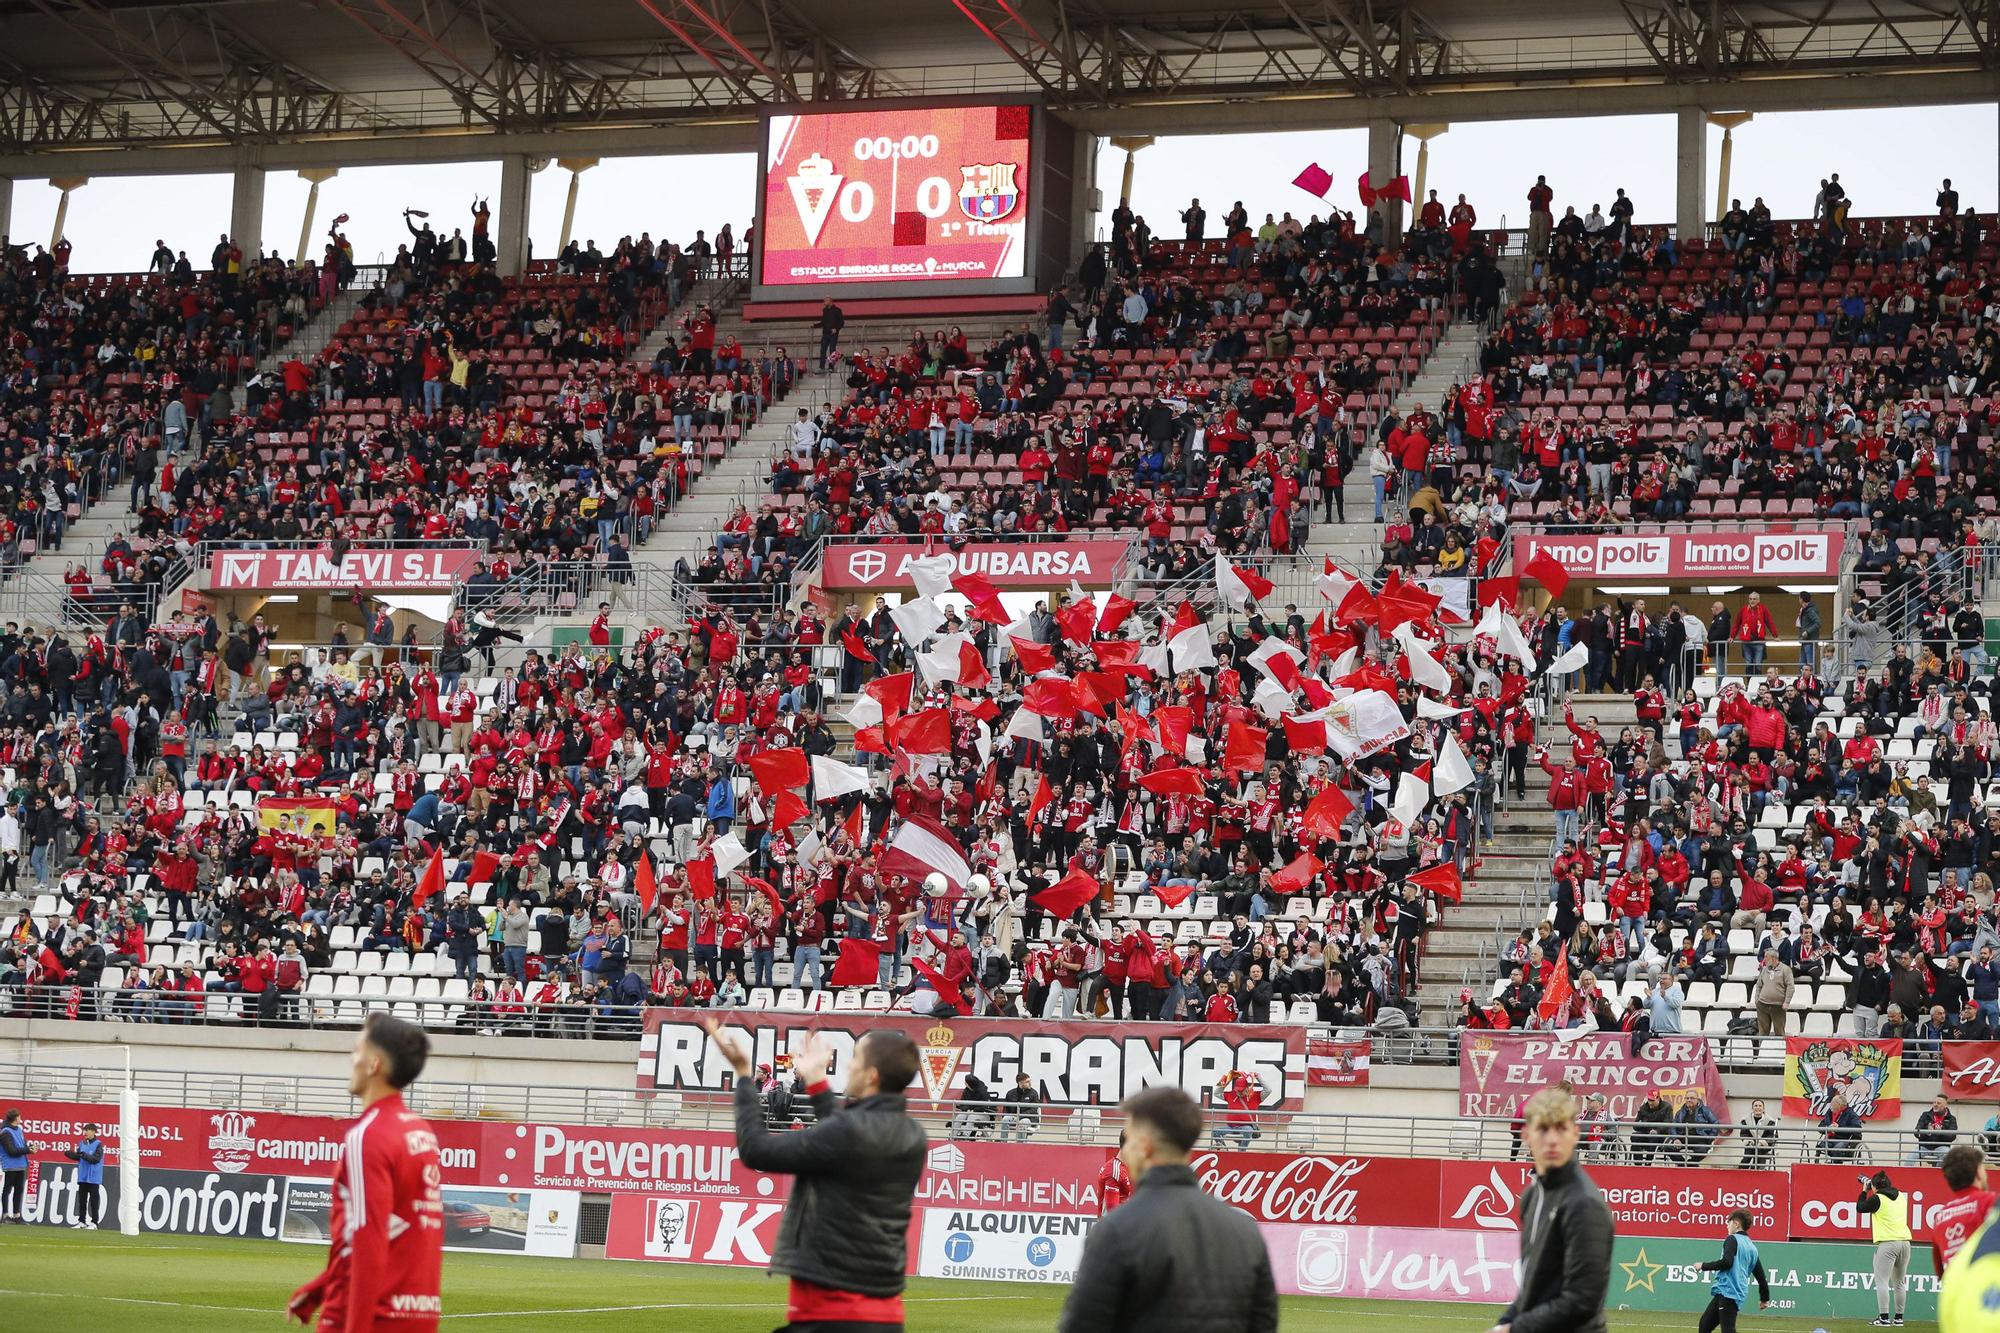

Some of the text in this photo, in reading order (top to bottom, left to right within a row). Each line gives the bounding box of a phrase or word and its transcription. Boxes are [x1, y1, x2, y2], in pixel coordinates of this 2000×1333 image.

[854, 134, 940, 161] 00:00
[839, 181, 875, 223] 0
[916, 176, 952, 219] 0
[790, 266, 837, 276] ESTADIO
[838, 264, 890, 275] ENRIQUE
[891, 262, 924, 273] ROCA
[942, 261, 986, 271] MURCIA
[276, 553, 393, 580] TAMEVI
[1601, 541, 1661, 571] polt
[1685, 538, 1819, 569] Inmo polt
[1522, 1034, 1624, 1060] PEÑA
[972, 1033, 1286, 1111] GRANAS
[1504, 1064, 1701, 1087] EL RINCON
[1465, 1093, 1530, 1117] REA
[534, 1126, 741, 1182] Prevemur
[291, 1189, 319, 1199] Porsche
[534, 1174, 740, 1195] Servicio de Prevención de Riesgos Laborales
[1188, 1152, 1371, 1223] Coca-Cola
[1685, 1186, 1704, 1206] de
[1710, 1187, 1774, 1210] Jesús
[118, 1174, 279, 1238] onfort
[942, 1265, 1048, 1282] SUMINISTROS
[1805, 1274, 1823, 1284] DE
